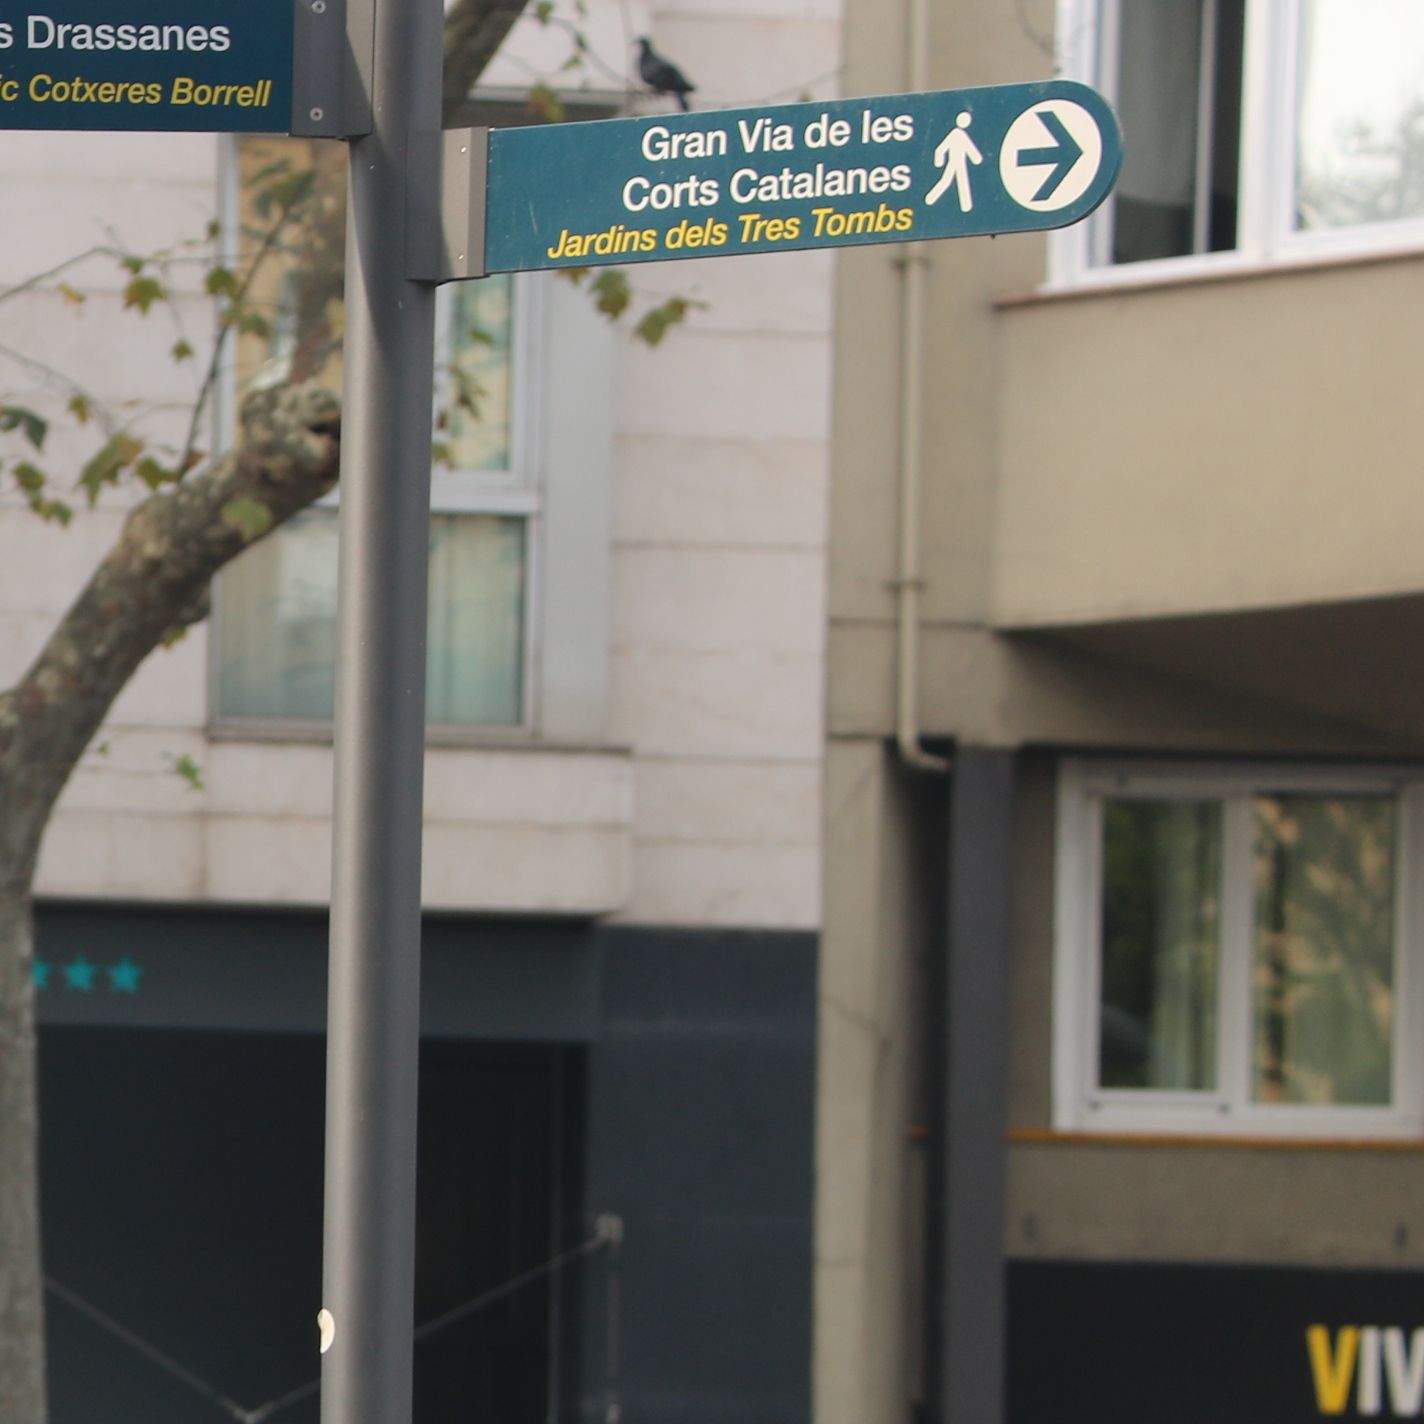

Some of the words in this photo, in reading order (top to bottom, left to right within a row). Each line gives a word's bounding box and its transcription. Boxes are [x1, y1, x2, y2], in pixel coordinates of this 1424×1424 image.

[27, 15, 231, 52] Drassanes
[28, 73, 161, 103] Cotxeres
[170, 77, 272, 107] Borrell
[641, 126, 727, 162] Gran
[738, 117, 794, 153] Via
[804, 112, 851, 149] de
[861, 109, 914, 145] les
[622, 176, 720, 212] Corts
[729, 163, 912, 205] Catalanes
[547, 223, 657, 259] Jardins
[664, 217, 728, 251] dels
[738, 213, 800, 243] Tres
[810, 202, 915, 237] Tombs
